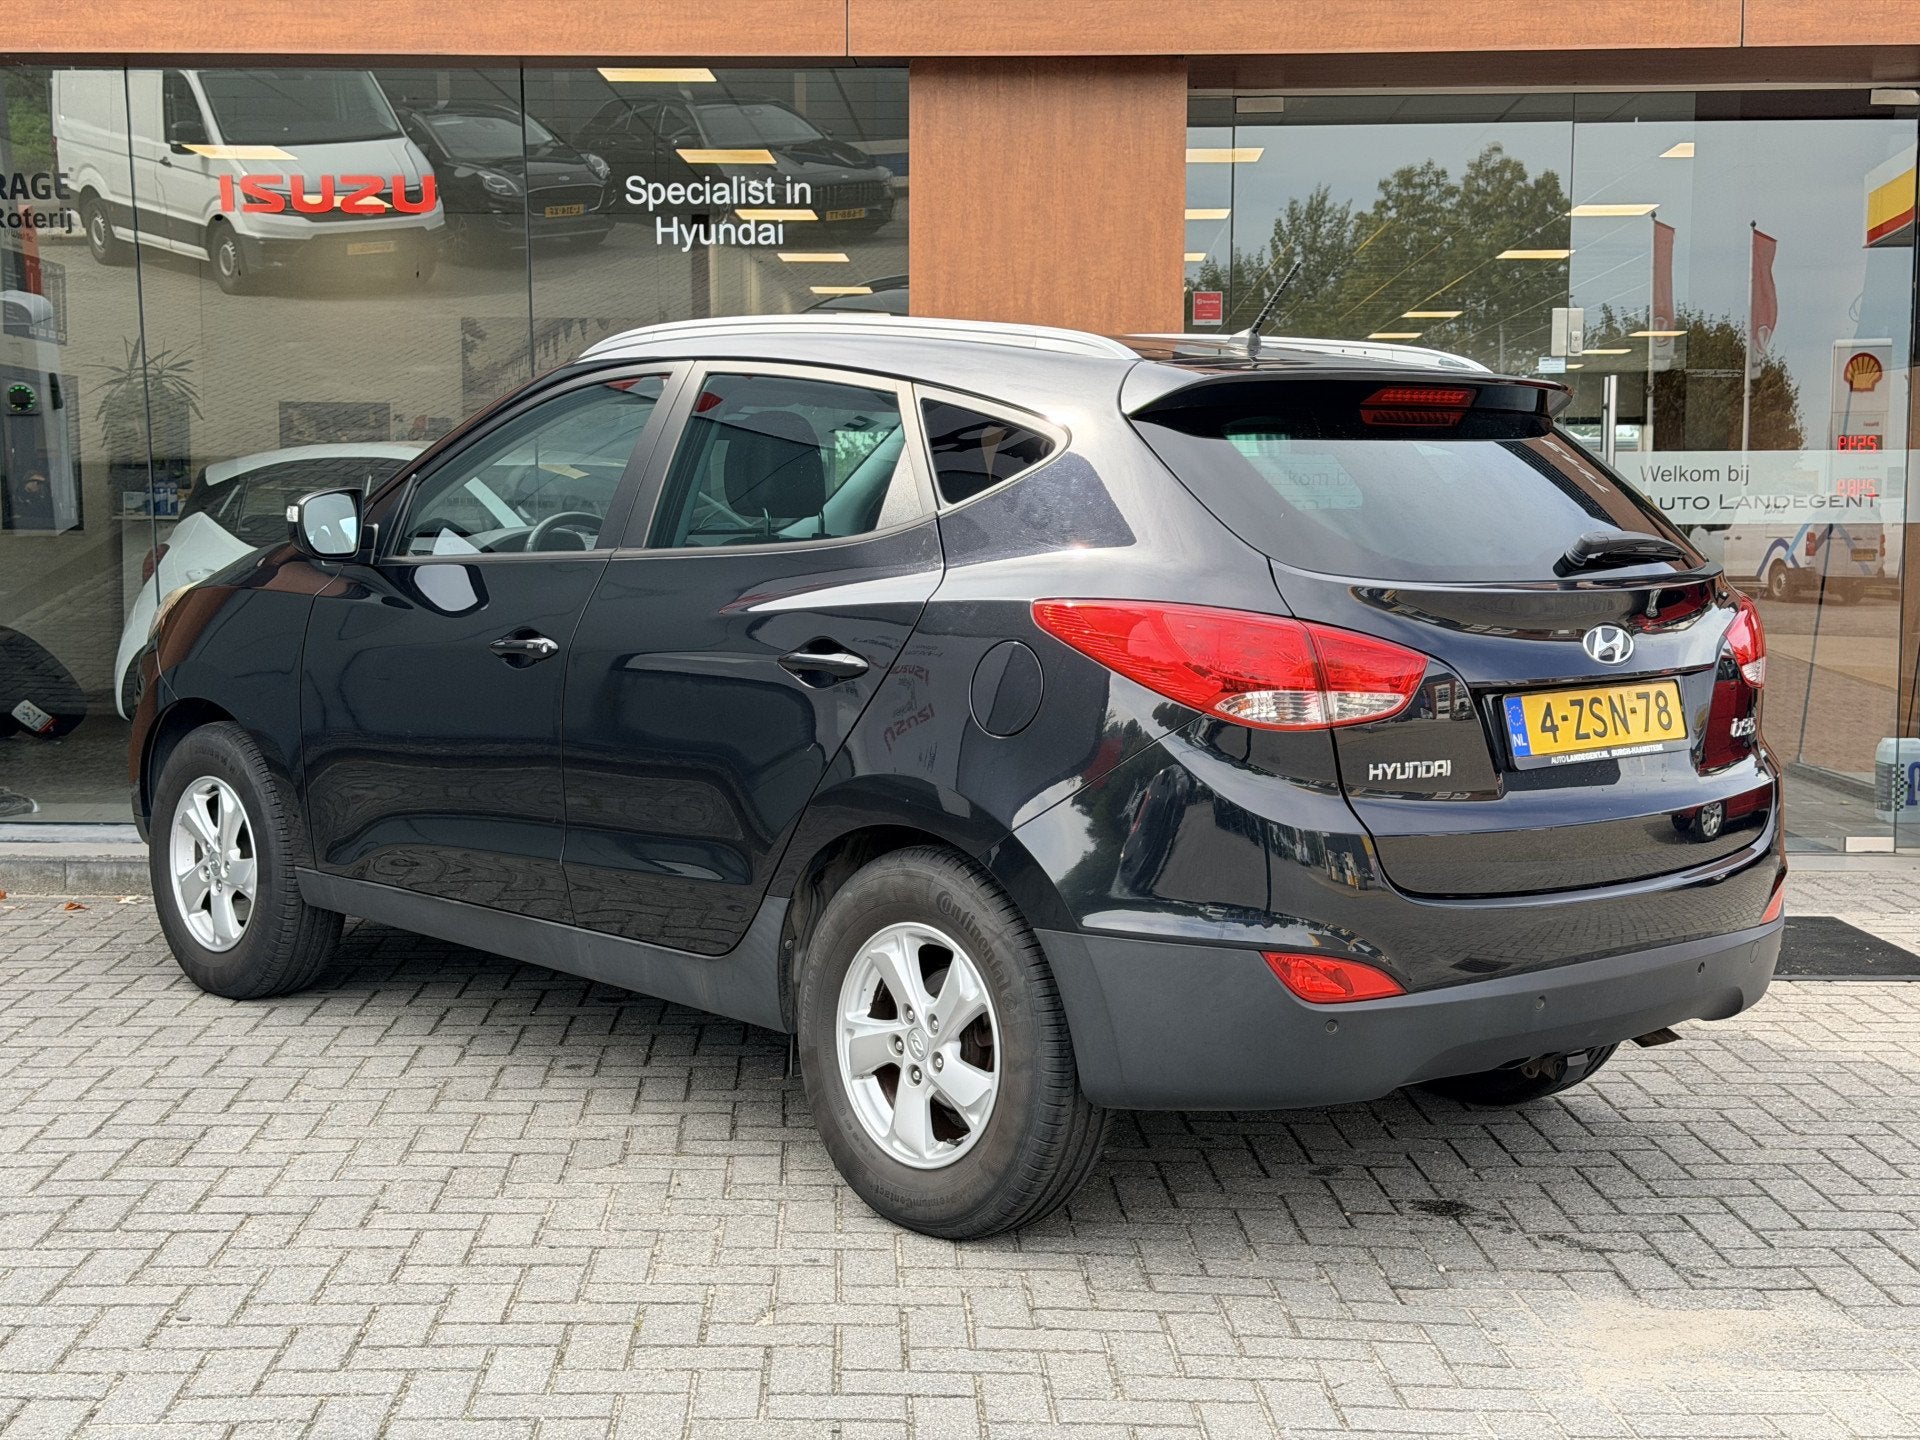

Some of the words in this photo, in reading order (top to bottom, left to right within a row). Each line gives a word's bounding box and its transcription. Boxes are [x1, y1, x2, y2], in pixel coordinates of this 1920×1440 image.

[219, 174, 437, 214] ISUZU
[625, 175, 776, 212] Specialist
[785, 175, 812, 205] in
[656, 216, 784, 253] Hyundai
[1640, 465, 1720, 483] Welkom
[1727, 464, 1750, 486] bij
[1719, 494, 1880, 510] LANDEGENT
[1540, 689, 1673, 743] 4-ZSN-78
[1512, 733, 1528, 748] NL
[1368, 759, 1452, 781] HYUNDAI
[936, 890, 1011, 993] Continental
